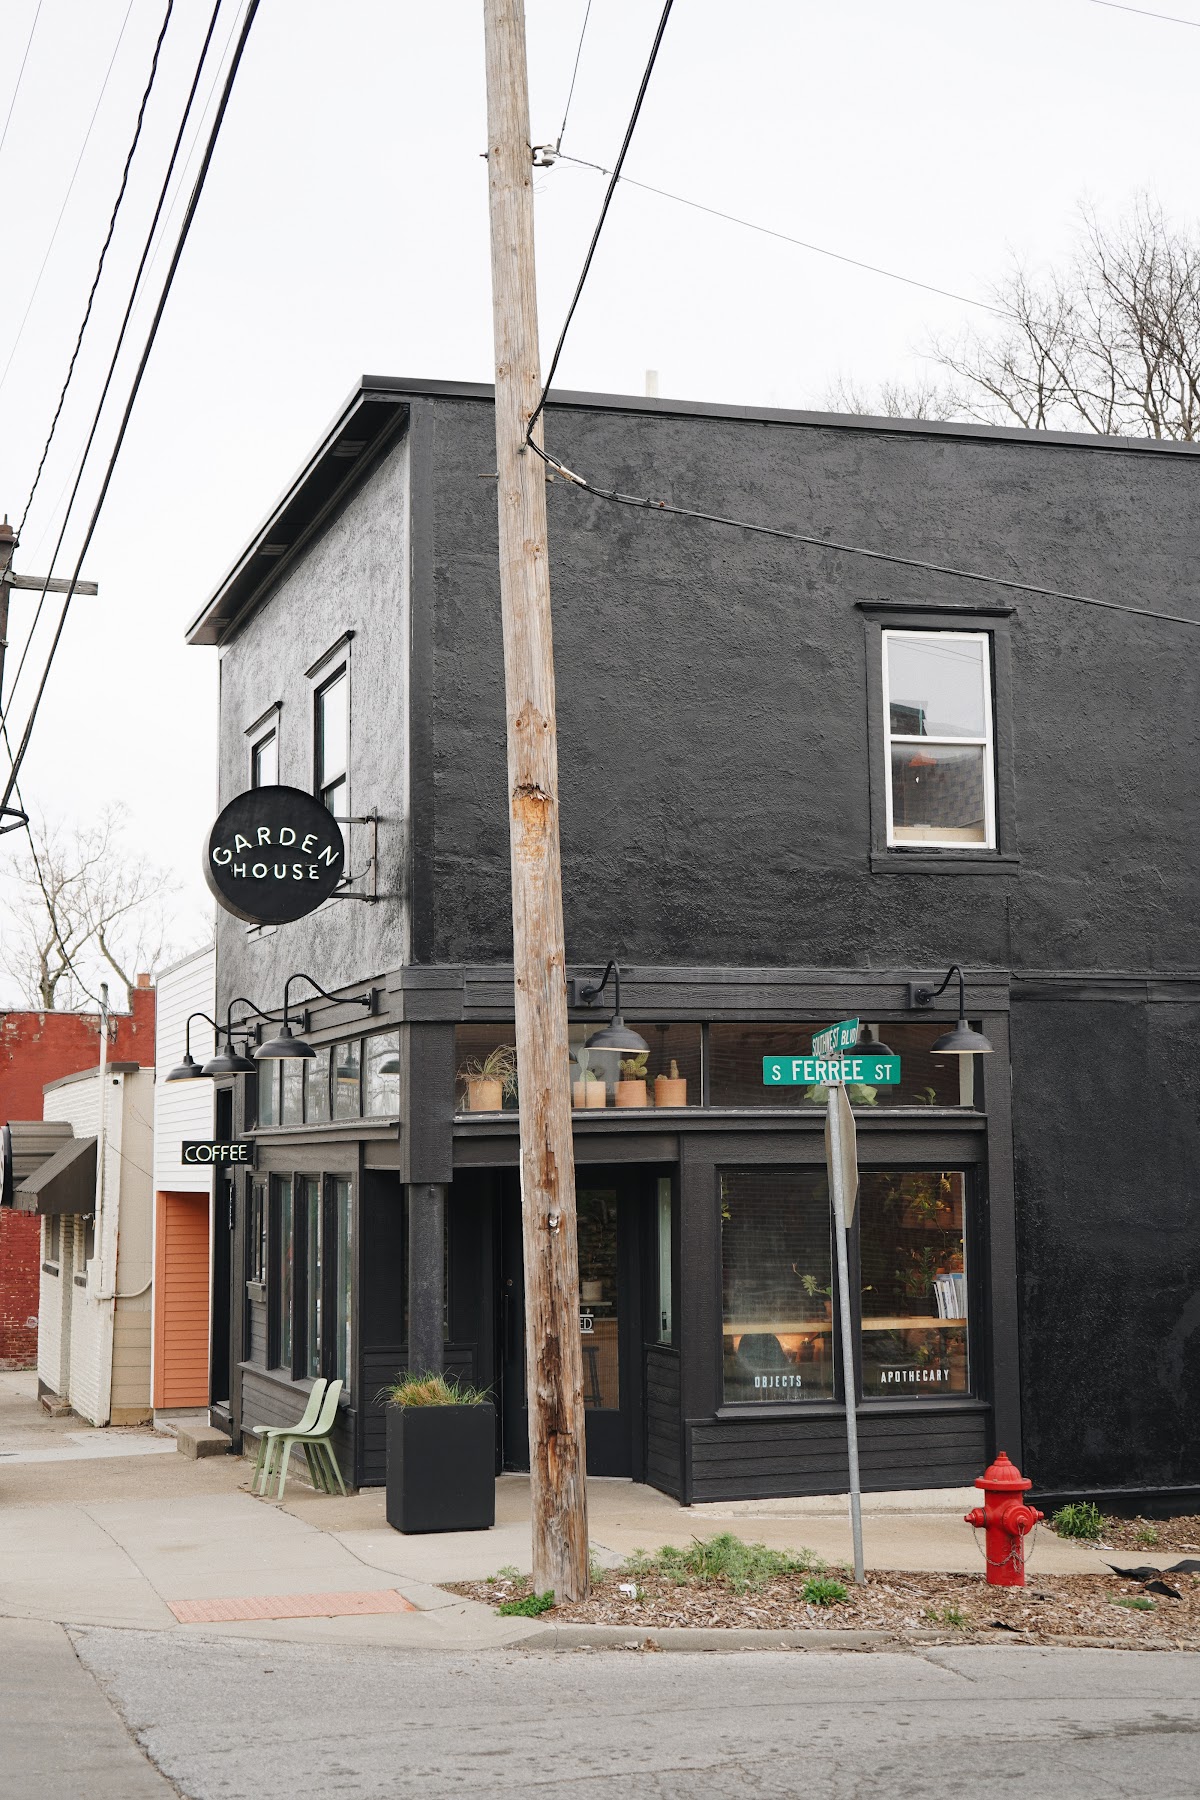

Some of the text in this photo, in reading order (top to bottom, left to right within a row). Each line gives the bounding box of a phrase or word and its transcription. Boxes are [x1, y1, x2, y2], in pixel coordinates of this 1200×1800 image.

[212, 827, 339, 866] GARDEN
[234, 863, 319, 880] HOUSE
[841, 1027, 858, 1046] BLVD
[771, 1059, 892, 1081] S FERREE ST
[184, 1144, 248, 1163] COFFEE
[754, 1375, 802, 1388] OBJECTS
[880, 1369, 950, 1383] APOTHECARY
